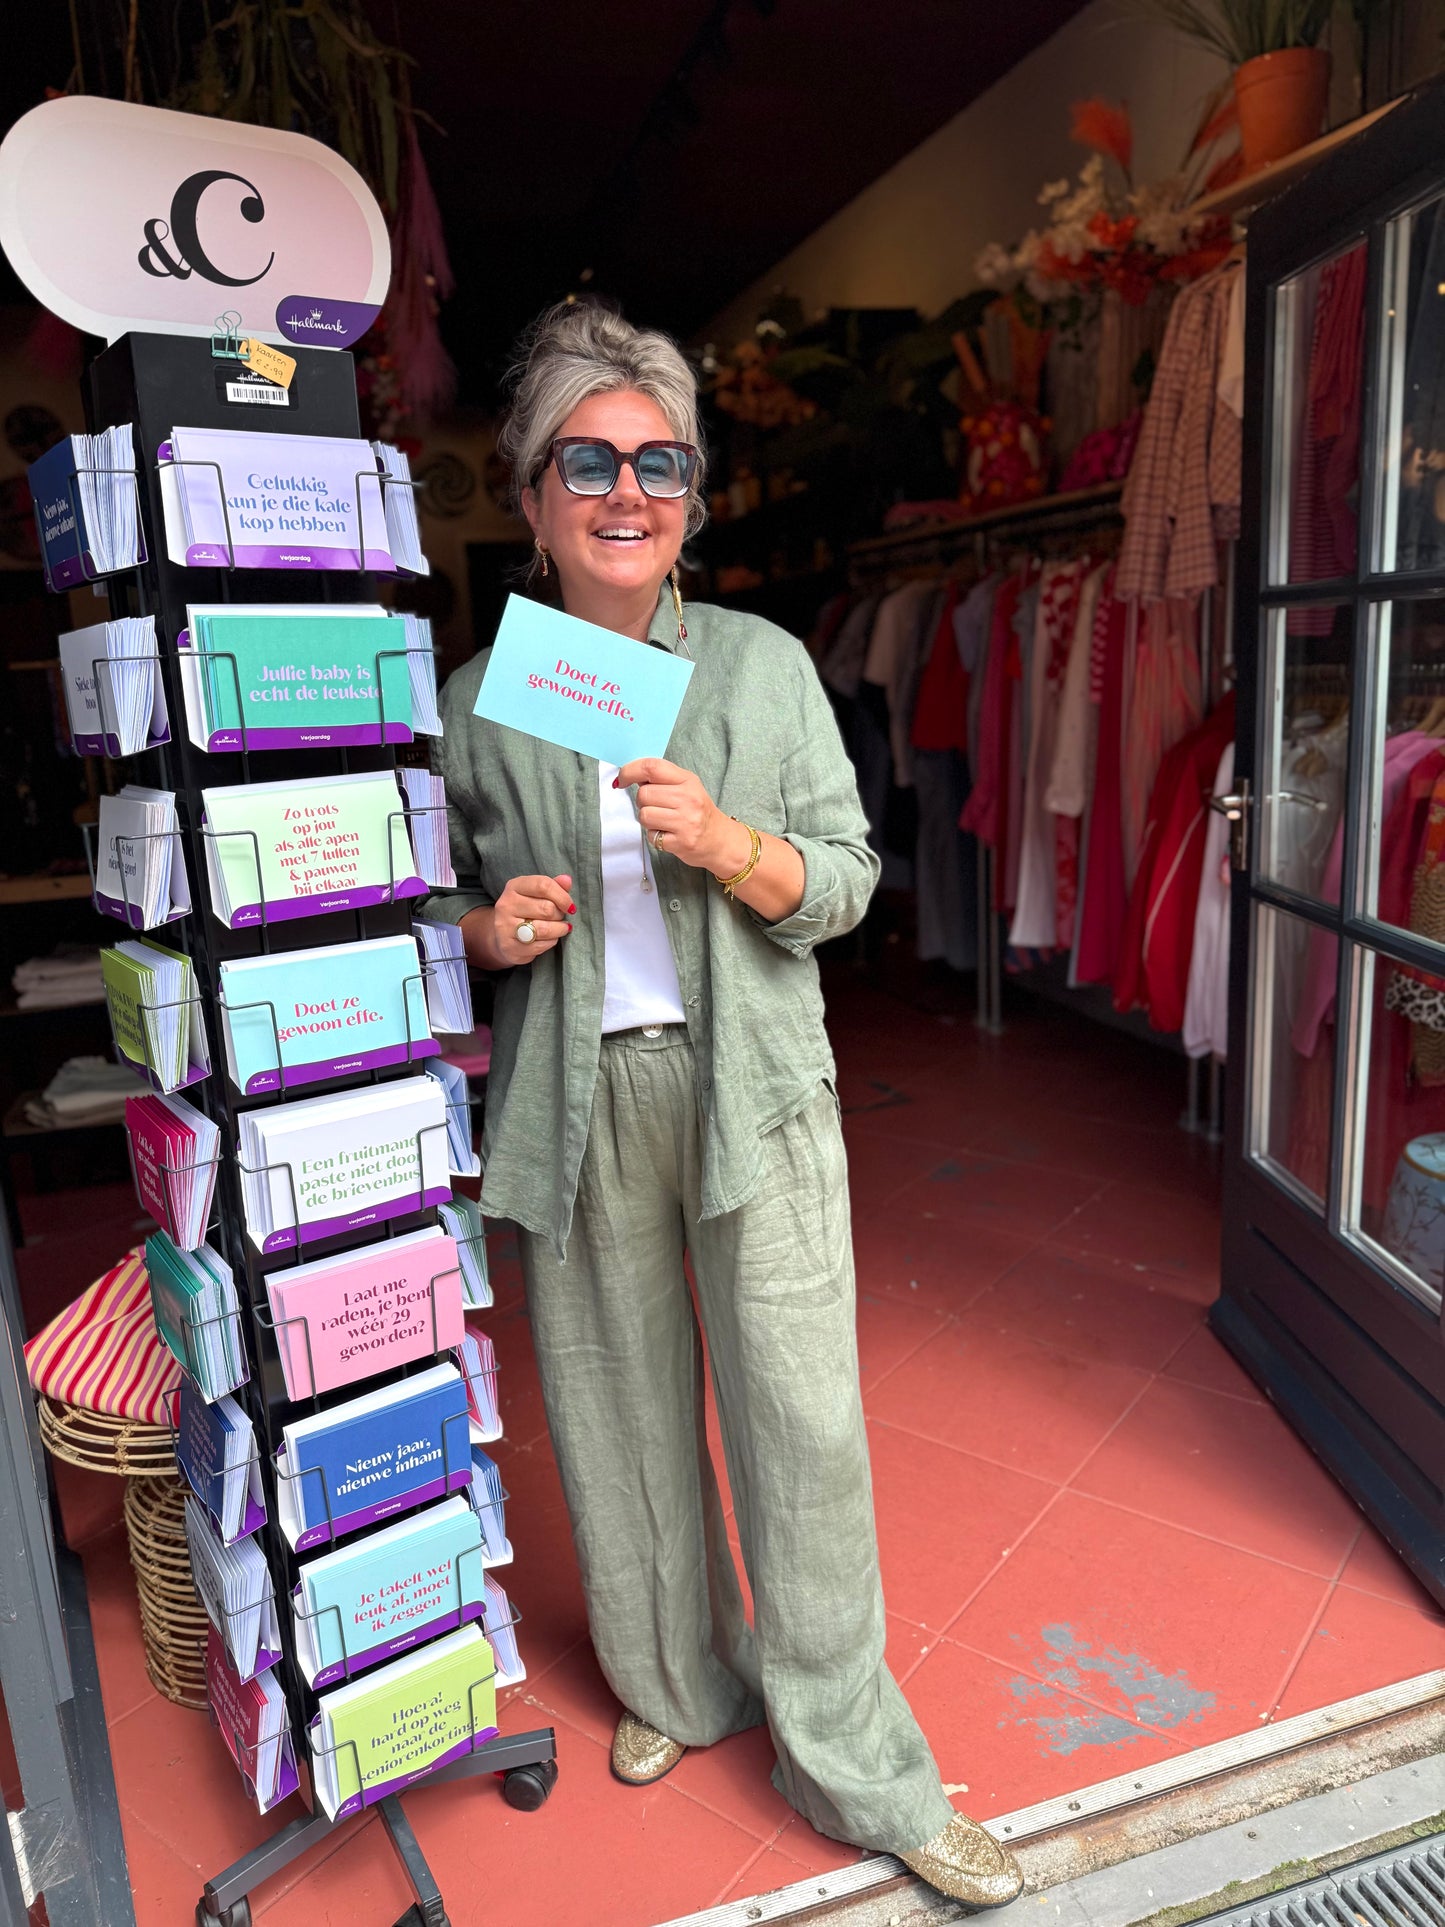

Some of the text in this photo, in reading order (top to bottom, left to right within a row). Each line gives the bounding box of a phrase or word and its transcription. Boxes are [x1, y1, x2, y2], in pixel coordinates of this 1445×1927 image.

[285, 314, 347, 334] Hallmark
[247, 472, 328, 496] Gelukkig
[261, 494, 277, 513] je
[283, 495, 310, 511] die
[315, 498, 351, 514] kale
[239, 513, 346, 533] kop hebben
[279, 554, 311, 563] Verjaardag
[257, 664, 371, 682] Jullie baby is
[555, 659, 621, 696] Doet ze
[250, 686, 291, 702] echt
[296, 686, 319, 701] de
[526, 673, 635, 722] gewoon effe.
[300, 734, 331, 742] Verjaardag
[283, 804, 339, 821] Zo trots
[293, 820, 336, 836] op jou
[274, 832, 359, 853] als alle apen
[280, 846, 360, 868] met 7 lullen
[289, 862, 357, 881] & pauwen
[294, 878, 358, 895] bij elkaar
[320, 898, 349, 908] Verjaardag
[294, 995, 361, 1018] Doet ze
[277, 1010, 384, 1043] gewoon effe.
[333, 1060, 362, 1071] Verjaardag
[302, 1156, 335, 1175] Een
[300, 1170, 346, 1195] paste
[351, 1160, 381, 1180] niet
[306, 1168, 420, 1208] de brievenbus
[348, 1212, 376, 1225] Verjaardag
[344, 1277, 408, 1306] Laat me
[378, 1299, 393, 1315] je
[397, 1285, 432, 1307] bent
[348, 1308, 411, 1340] wéér 29
[339, 1320, 426, 1363] geworden?
[346, 1437, 431, 1477] Nieuw jaar,
[336, 1448, 442, 1497] nieuwe inham
[375, 1502, 401, 1516] Verjaardag
[355, 1558, 452, 1608] Je takelt wel
[354, 1604, 388, 1625] leuk
[413, 1575, 451, 1600] moet
[371, 1595, 442, 1633] ik zeggen
[393, 1691, 443, 1724] Hoera!
[371, 1700, 462, 1749] hard op weg
[391, 1720, 447, 1754] naar de
[361, 1716, 479, 1783] seniorenkorting!
